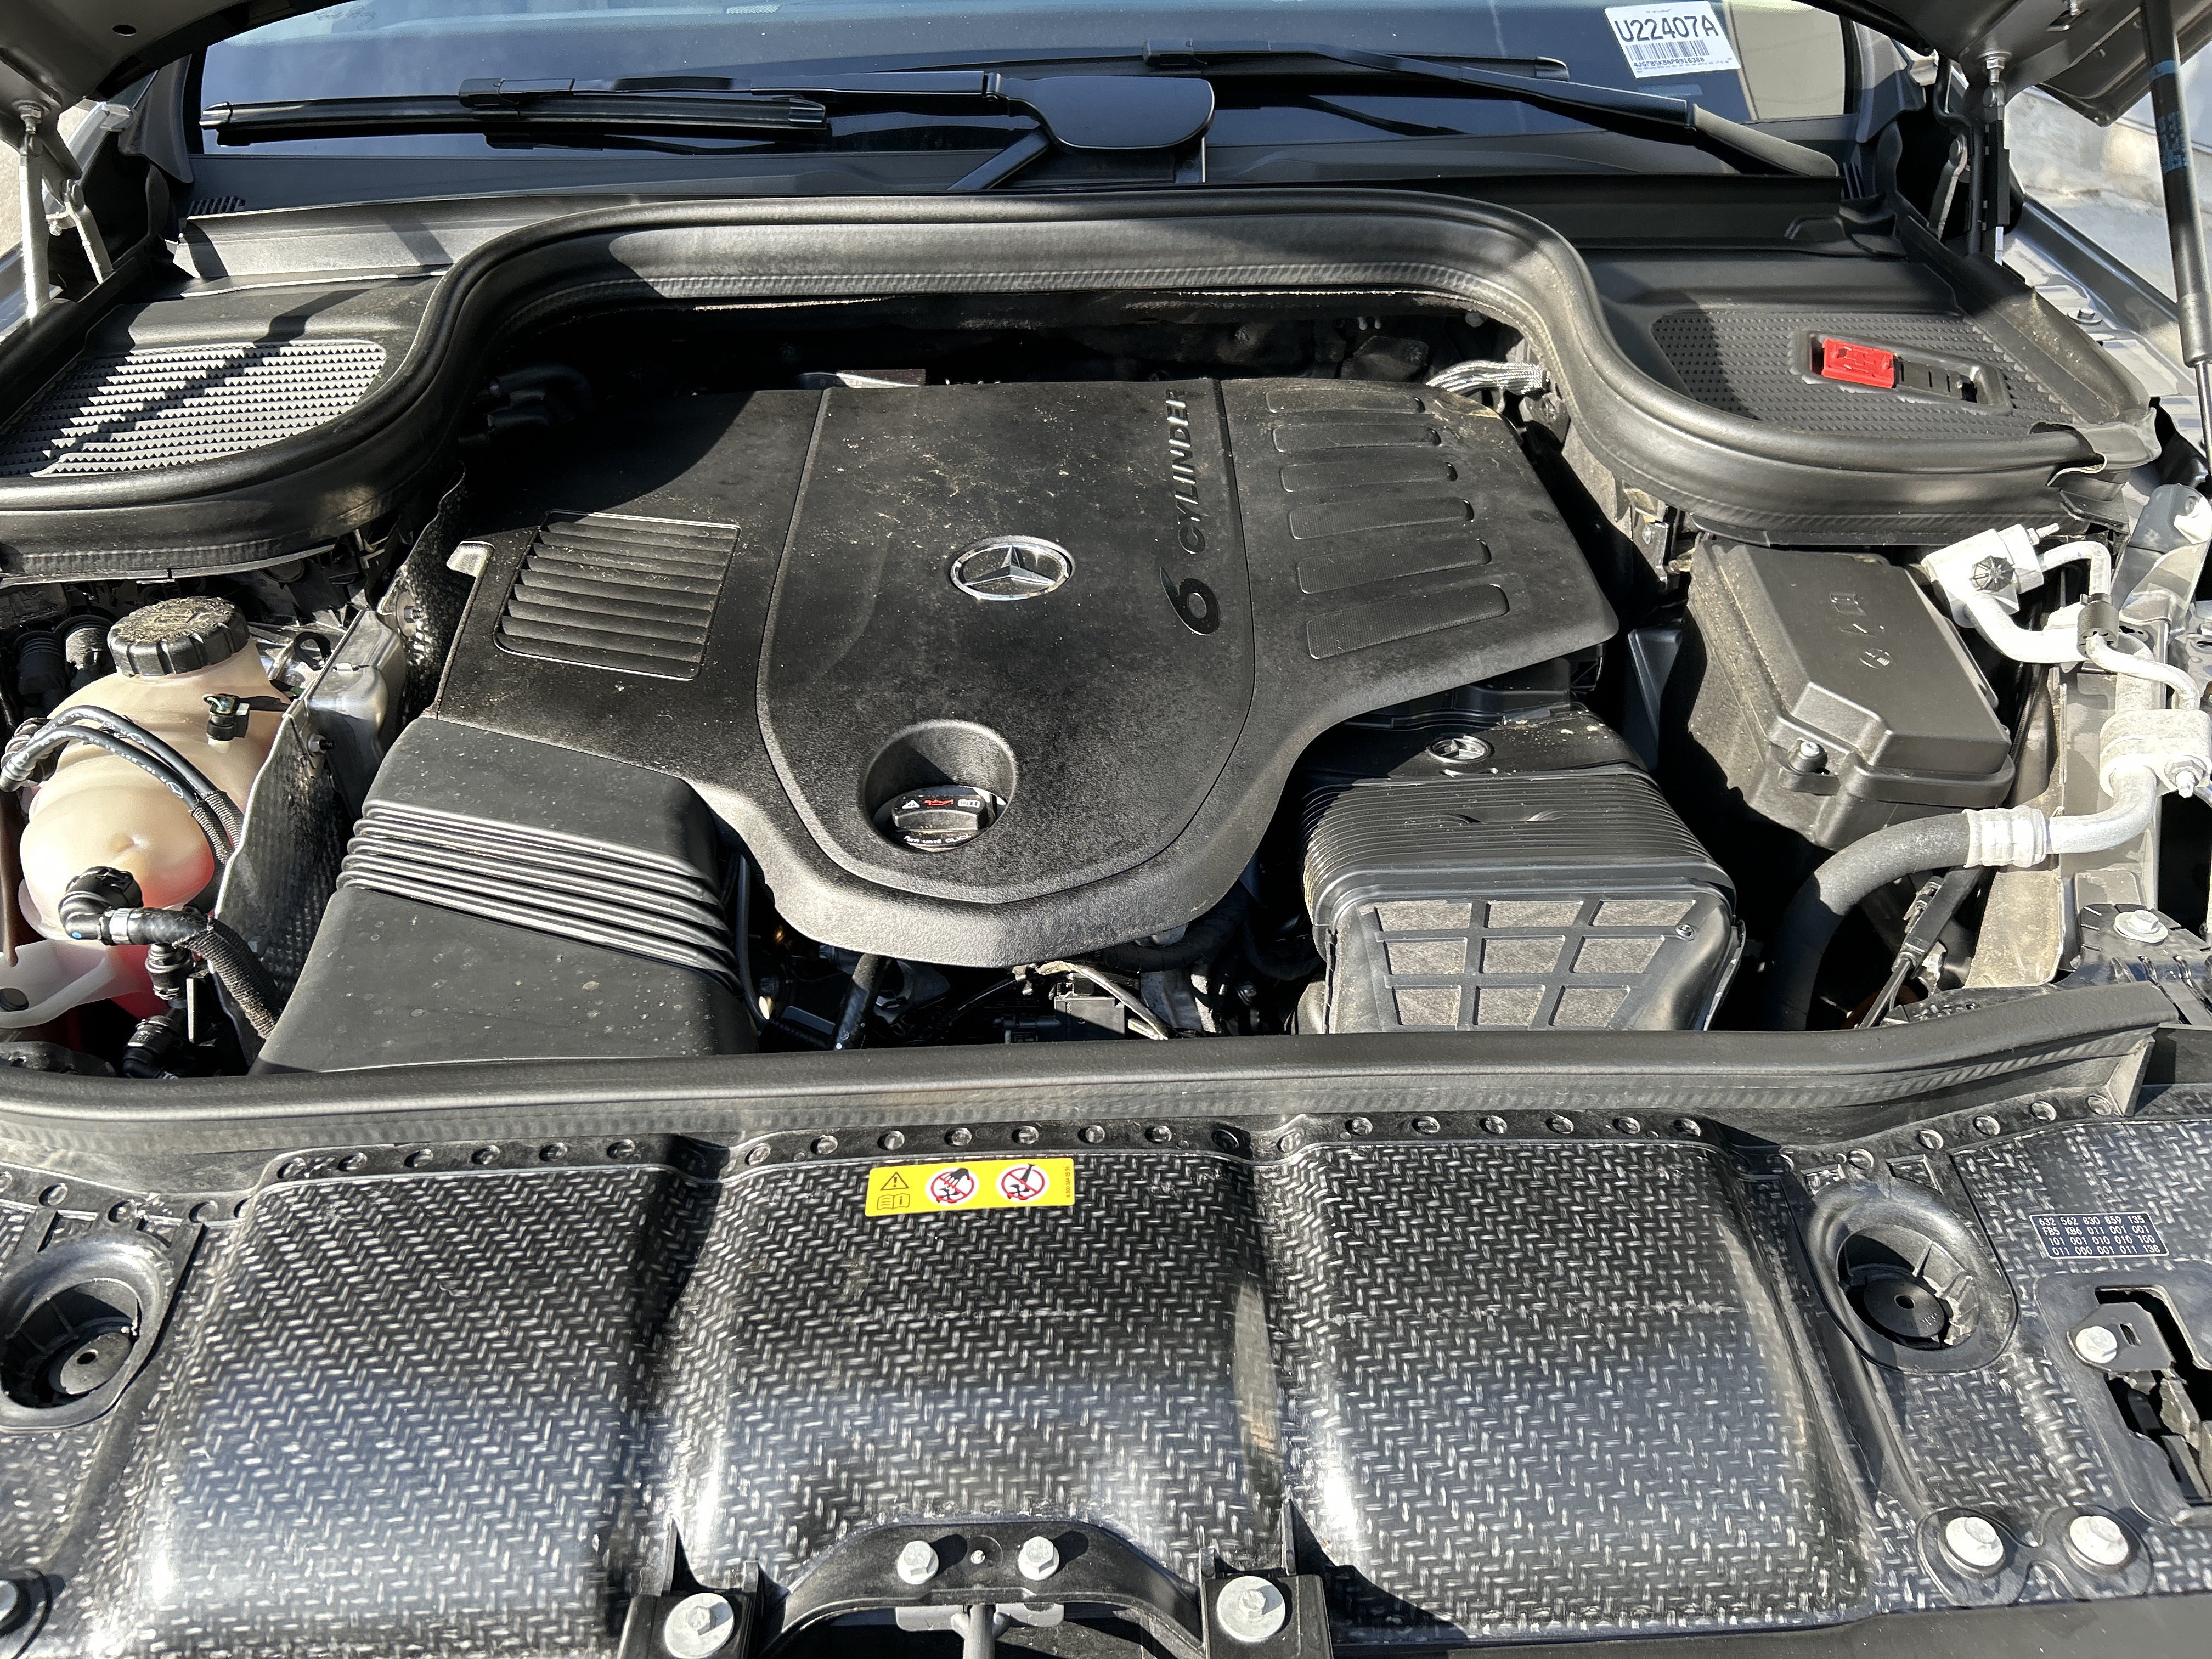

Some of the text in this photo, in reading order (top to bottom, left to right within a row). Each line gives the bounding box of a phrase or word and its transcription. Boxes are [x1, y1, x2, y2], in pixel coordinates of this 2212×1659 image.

[1615, 15, 1719, 42] U22407A
[1160, 388, 1220, 636] 6 CYLINDER
[945, 834, 972, 843] CLICK
[2039, 1215, 2145, 1226] 632 562 830 859 135
[2042, 1227, 2060, 1235] FB5
[2065, 1227, 2083, 1235] KB6
[2109, 1226, 2128, 1234] 001
[2131, 1225, 2149, 1233] 001
[2049, 1234, 2155, 1245] 101 001 010 010 100
[2052, 1244, 2160, 1255] 011 000 001 011 138
